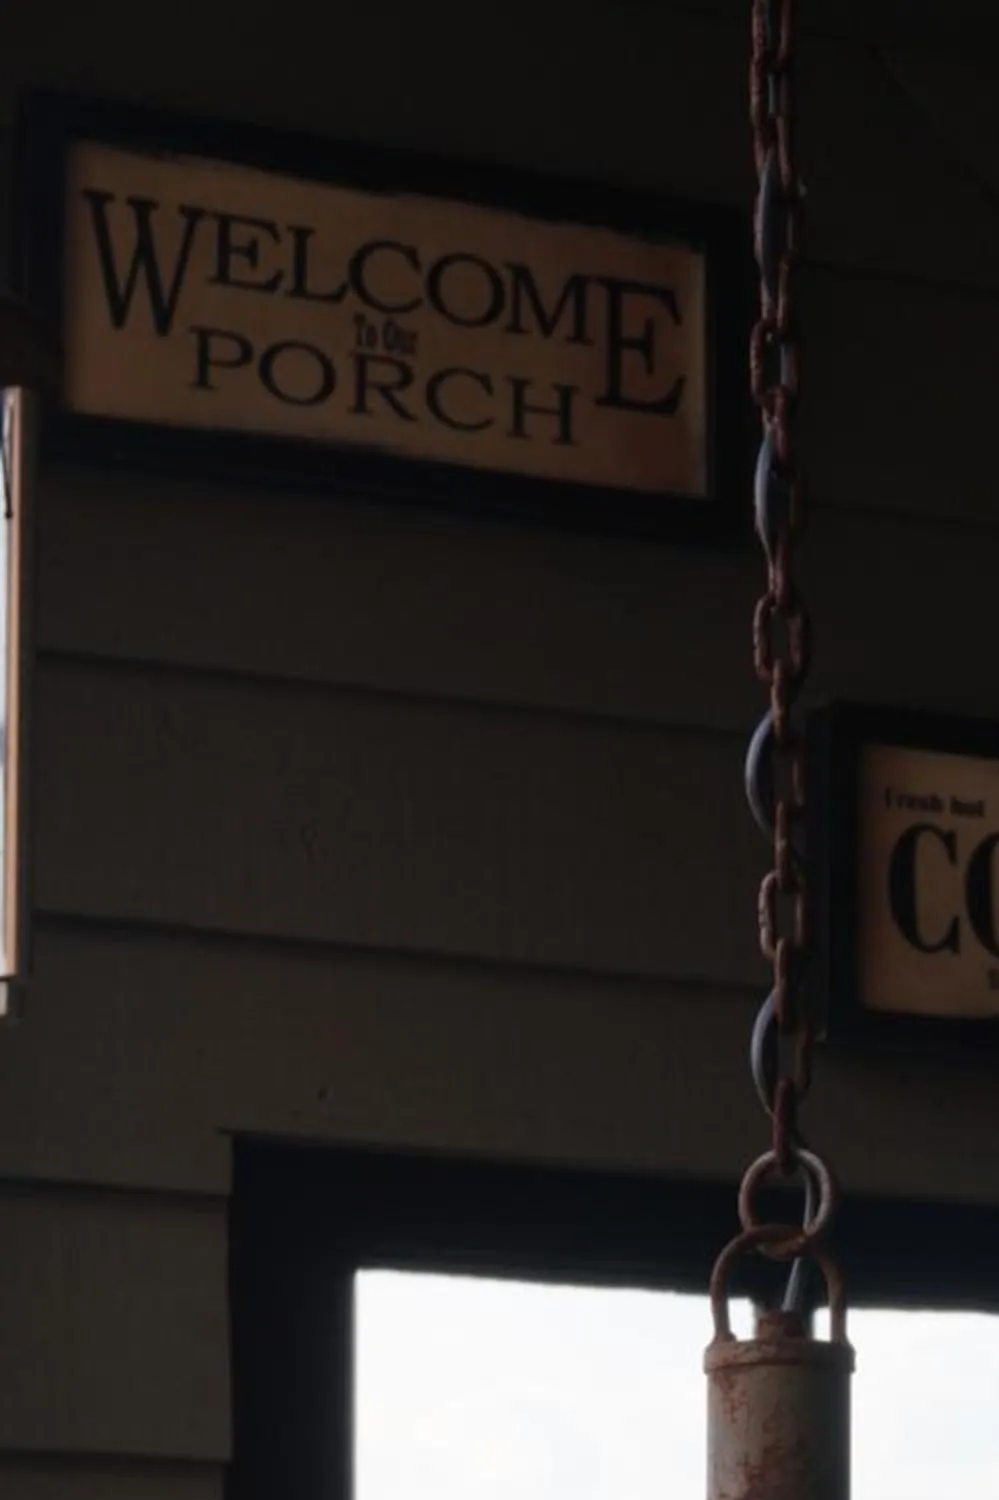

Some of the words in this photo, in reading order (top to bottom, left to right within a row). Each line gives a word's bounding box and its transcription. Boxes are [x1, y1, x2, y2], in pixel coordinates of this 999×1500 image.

[82, 188, 686, 416] WELCOME
[353, 308, 377, 347] To
[383, 315, 418, 354] Our
[188, 324, 580, 447] PORCH
